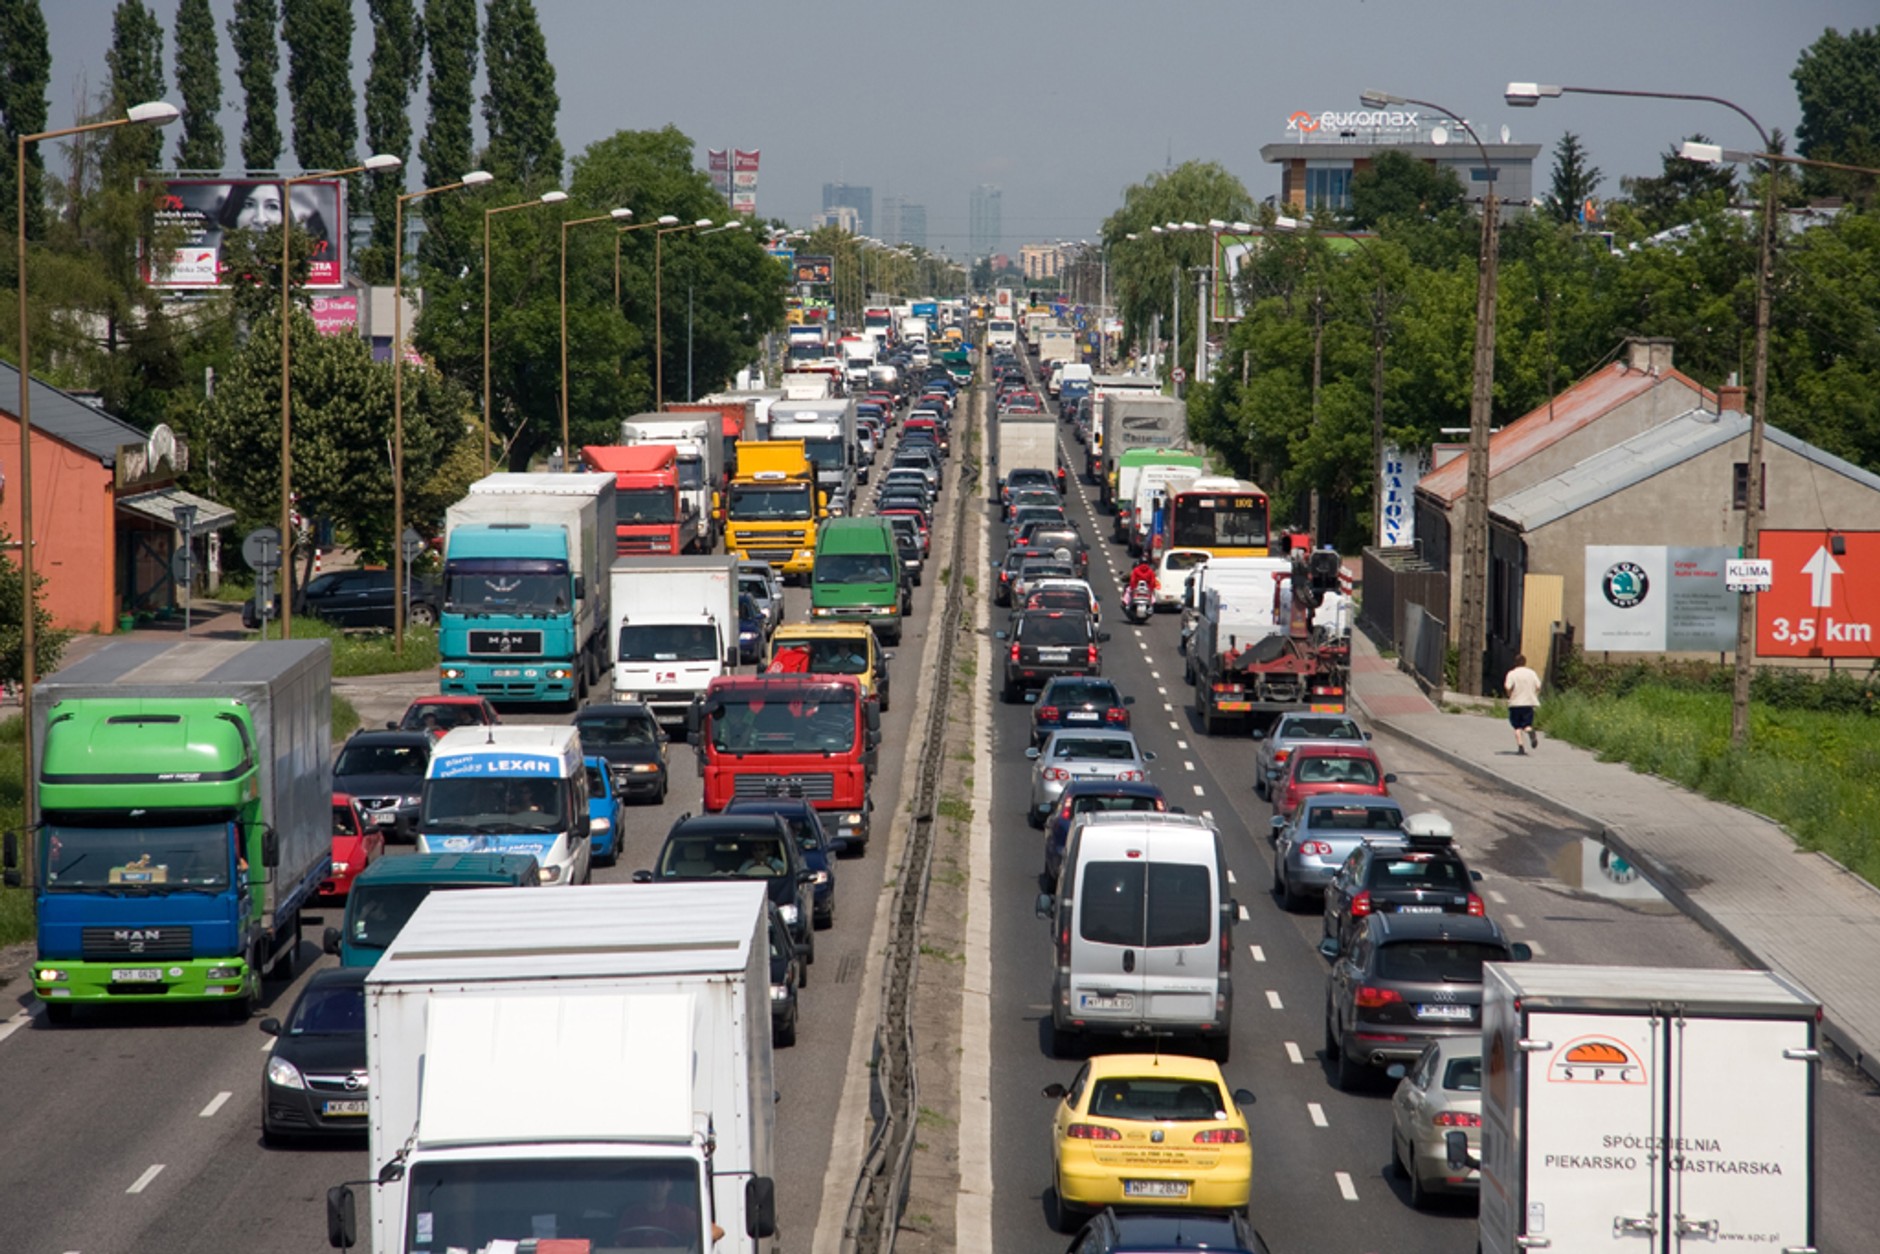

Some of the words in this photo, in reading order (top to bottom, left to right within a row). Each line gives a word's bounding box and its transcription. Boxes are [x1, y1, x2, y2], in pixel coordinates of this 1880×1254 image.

[1320, 111, 1419, 126] euromax
[1385, 462, 1402, 545] BALONY
[1729, 565, 1769, 577] KLIMA
[1772, 617, 1816, 646] 3,5
[1826, 617, 1872, 641] km
[488, 636, 523, 644] MAN
[487, 760, 551, 773] LEXAN
[113, 930, 161, 940] MAN
[1545, 1154, 1637, 1171] PIEKARSKO
[1718, 1231, 1780, 1243] www.spc.pl
